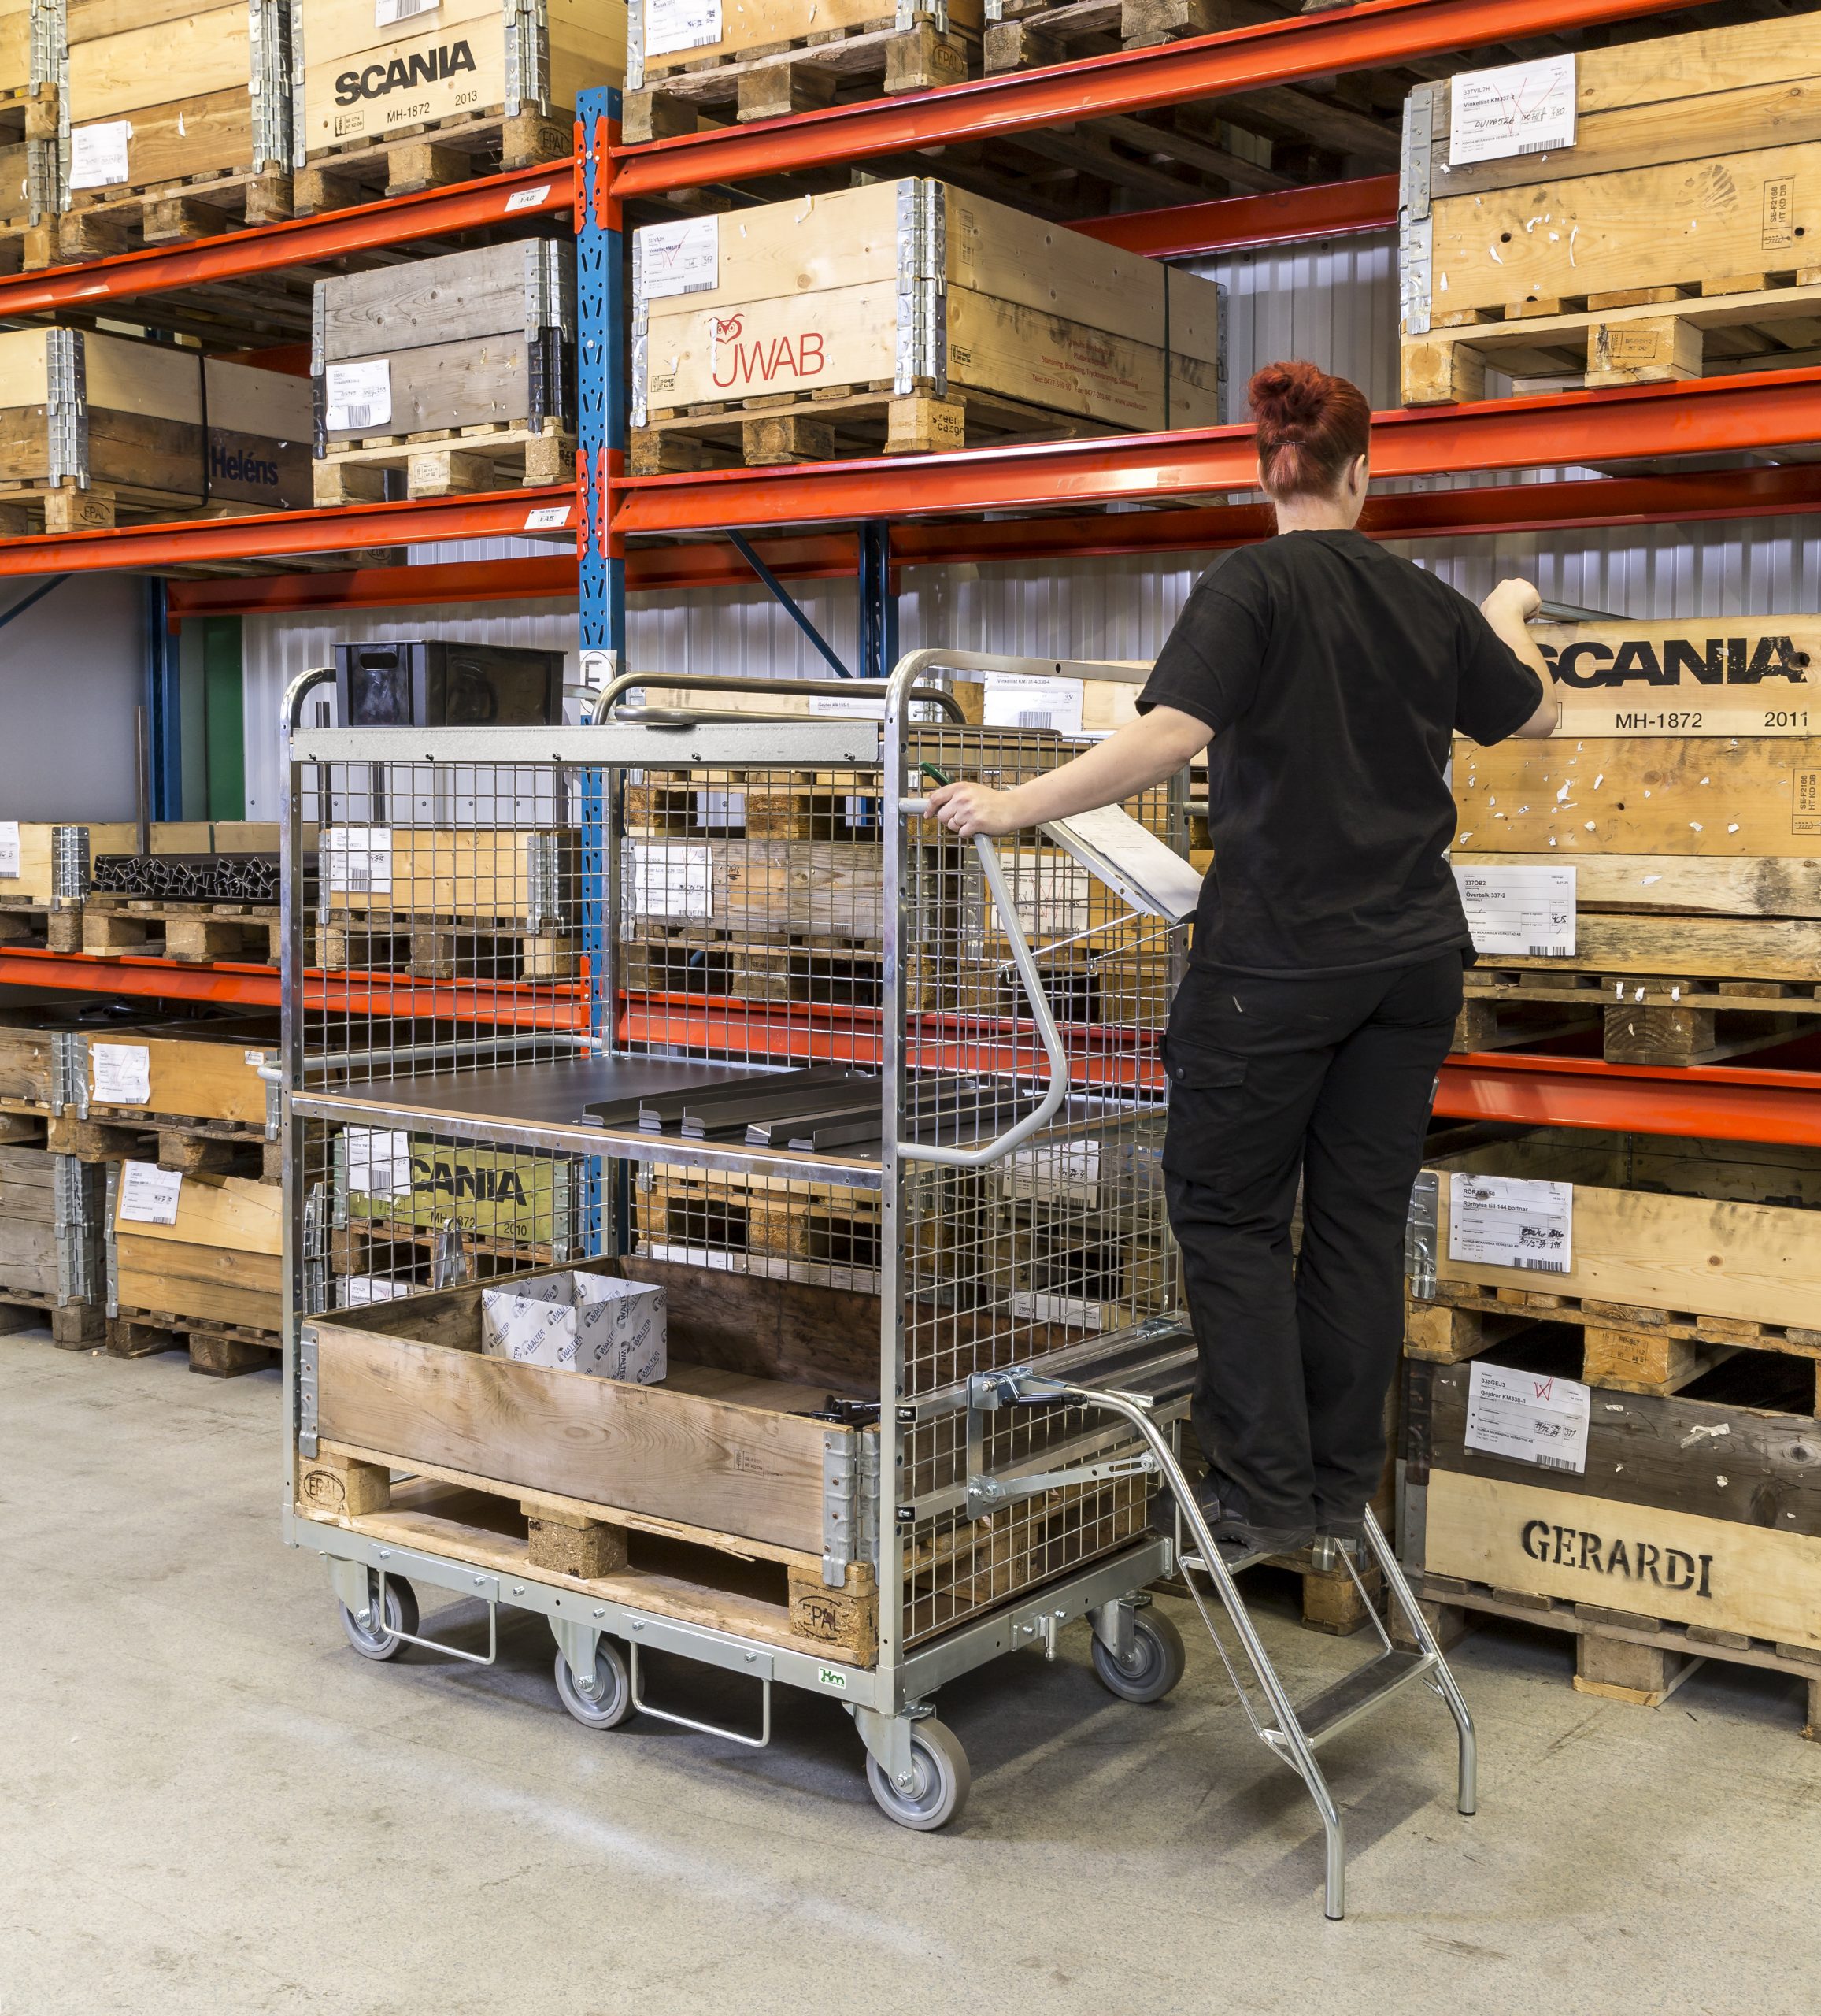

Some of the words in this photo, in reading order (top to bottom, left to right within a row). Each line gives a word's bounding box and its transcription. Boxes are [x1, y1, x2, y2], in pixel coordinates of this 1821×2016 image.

[335, 40, 476, 106] SCANIA
[1464, 86, 1490, 95] 337VIL2H
[387, 102, 430, 123] MH-1872
[455, 90, 478, 106] 2013
[1464, 99, 1490, 108] Vinkellist
[1490, 94, 1515, 103] KM337-2
[542, 130, 568, 154] EPAL
[1779, 184, 1786, 196] DB
[1779, 198, 1786, 209] KD
[1779, 212, 1786, 223] HT
[712, 332, 824, 387] UWAB
[211, 446, 279, 485] Heléns
[84, 506, 105, 520] EPAL
[1616, 712, 1703, 729] MH-1872
[1764, 710, 1808, 727] 2011
[1809, 774, 1816, 786] DB
[1808, 787, 1815, 799] KD
[1808, 799, 1815, 810] HT
[1551, 915, 1567, 924] 405
[1463, 1200, 1487, 1209] Rörhylsa
[430, 1211, 476, 1228] MH872
[504, 1222, 527, 1236] 2010
[491, 1322, 510, 1345] WALTER
[527, 1329, 546, 1351] WALTER
[633, 1319, 652, 1347] WALTER
[641, 1351, 661, 1378] WALTER
[1481, 1378, 1505, 1388] 338GEJ3
[1480, 1390, 1501, 1399] Gejdrar
[1501, 1395, 1526, 1404] KM338-3
[1521, 1519, 1713, 1599] GERARDI
